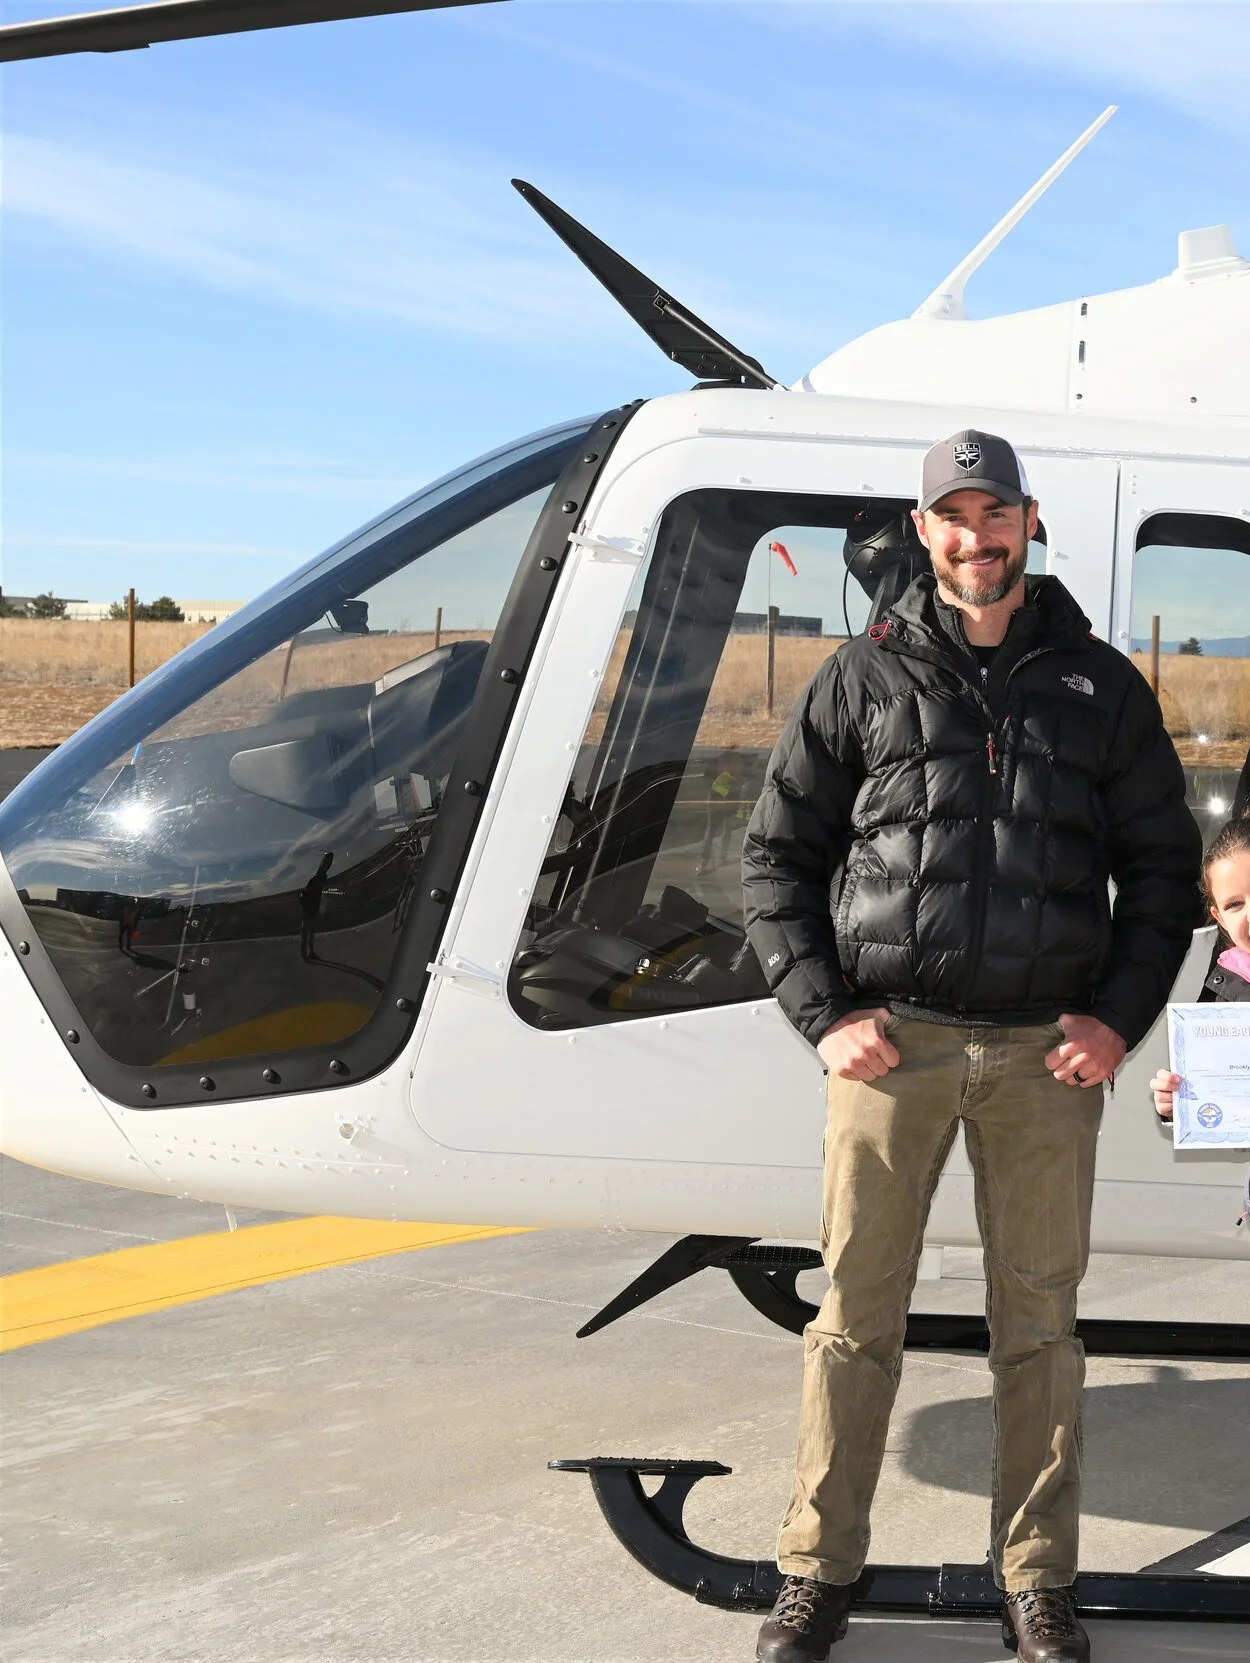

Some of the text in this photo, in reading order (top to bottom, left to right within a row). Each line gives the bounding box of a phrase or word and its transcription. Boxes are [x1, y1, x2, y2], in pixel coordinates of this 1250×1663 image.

[955, 444, 979, 452] BELL
[1061, 676, 1084, 686] NORTH
[1072, 673, 1085, 681] THE
[1067, 682, 1084, 692] FACE
[1192, 1025, 1229, 1038] YOUNG
